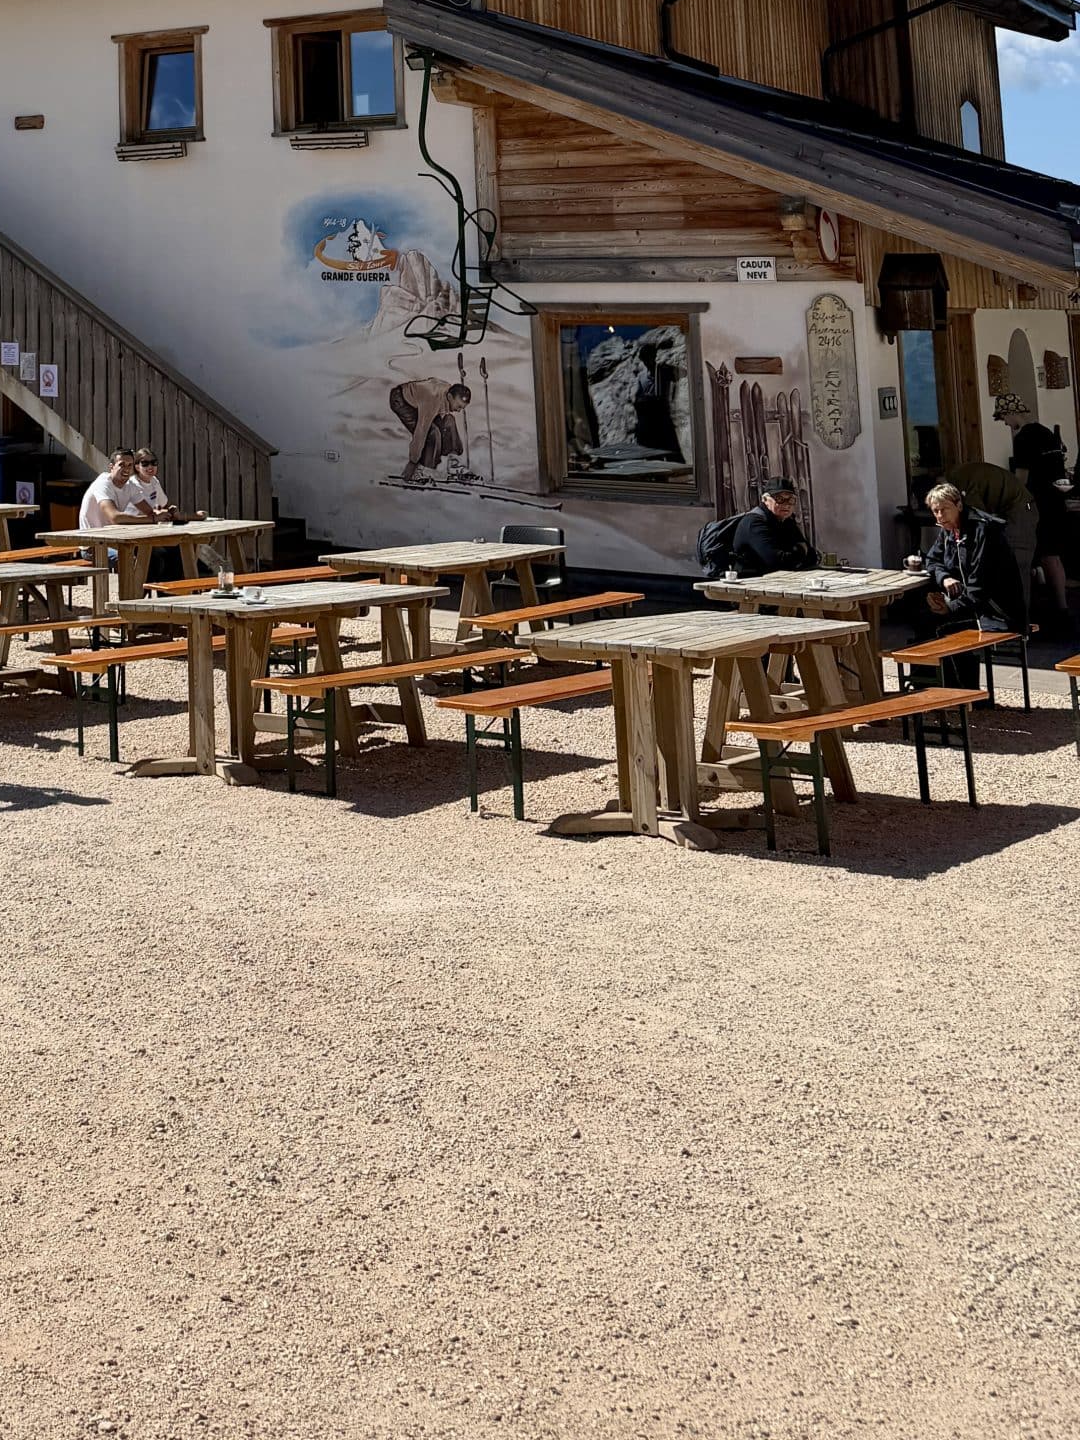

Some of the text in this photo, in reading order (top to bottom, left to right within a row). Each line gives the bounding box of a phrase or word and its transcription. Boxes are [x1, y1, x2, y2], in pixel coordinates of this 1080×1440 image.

[740, 260, 772, 269] CADUTA
[321, 271, 391, 282] GRANDE GUERRA
[746, 271, 768, 280] NEVE
[818, 335, 842, 347] 2416
[824, 370, 843, 436] ENTRATA
